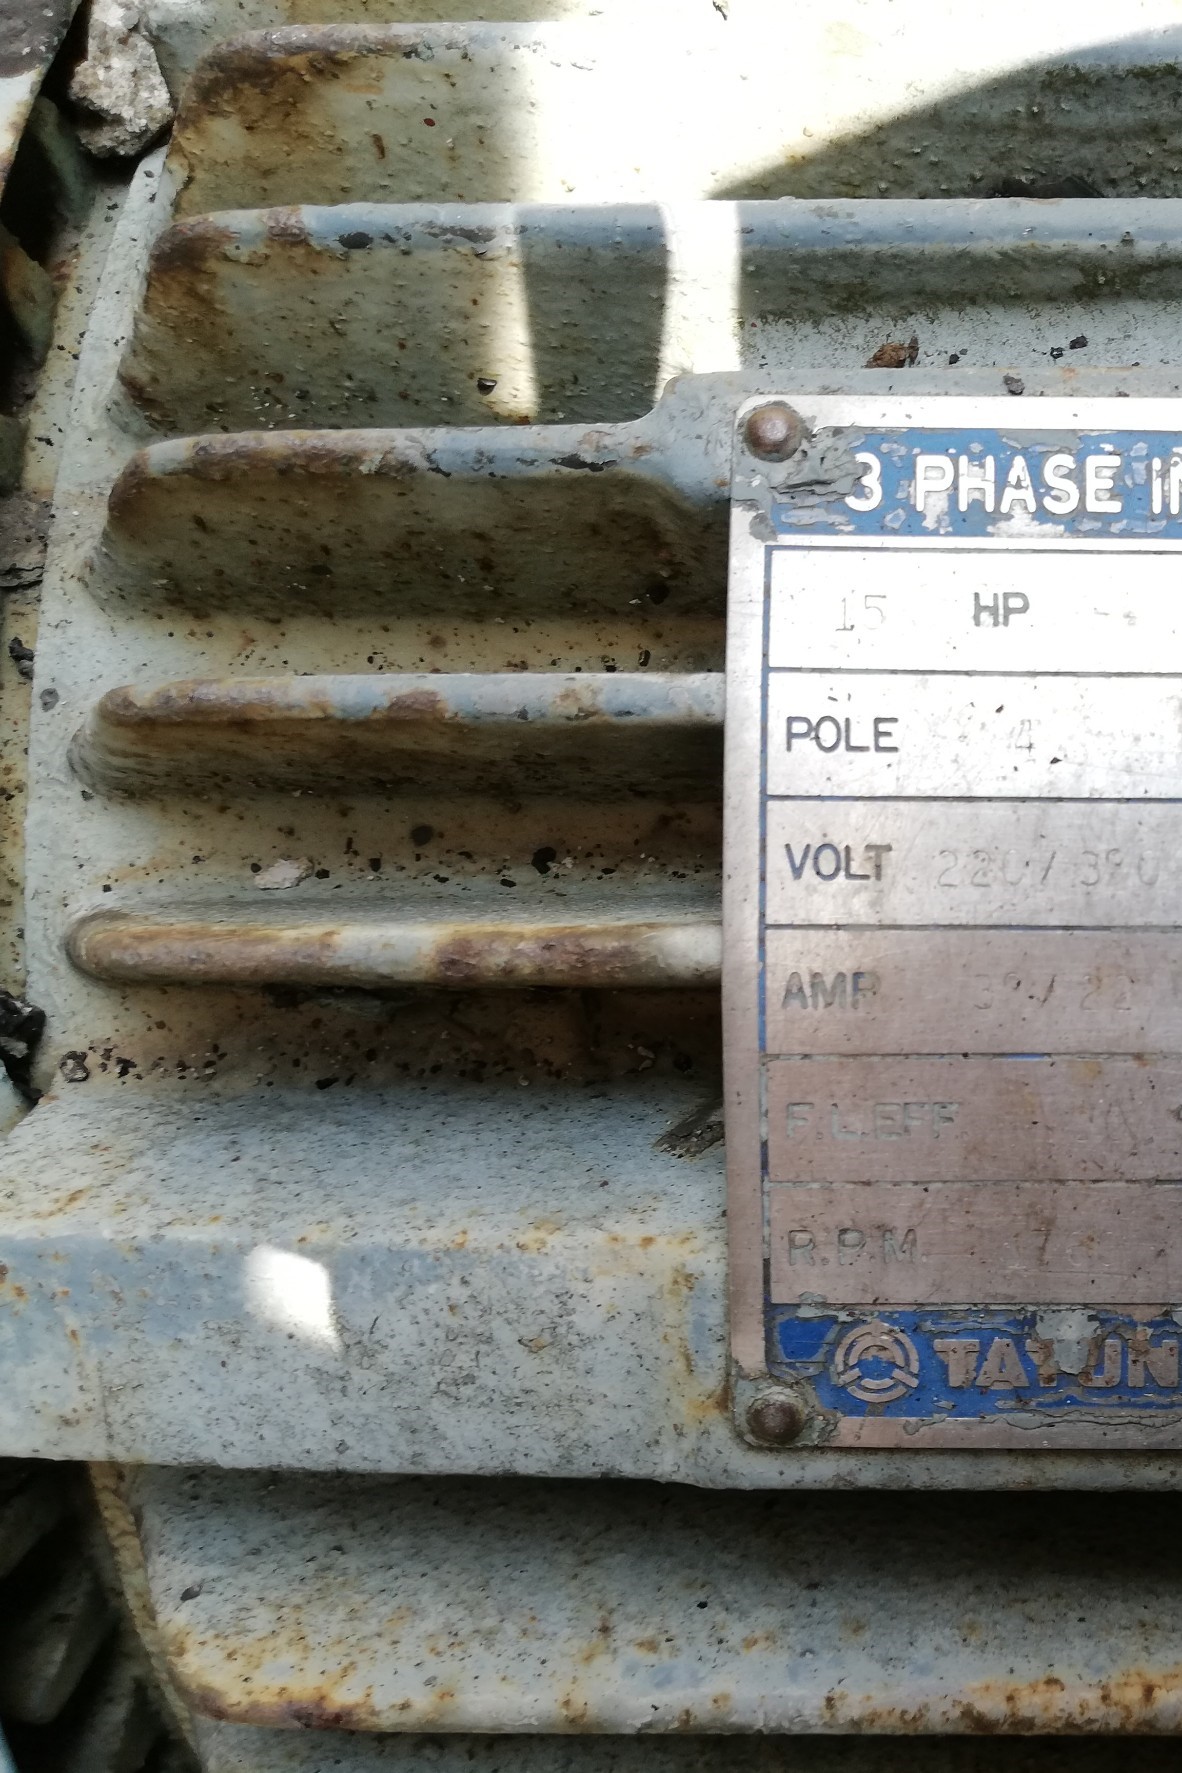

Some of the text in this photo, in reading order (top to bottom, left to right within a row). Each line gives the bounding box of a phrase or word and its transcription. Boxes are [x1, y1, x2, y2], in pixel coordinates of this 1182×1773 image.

[844, 453, 882, 512] 3
[914, 453, 1123, 515] PHASE
[972, 592, 1030, 627] HP
[786, 715, 898, 754] POLE
[784, 843, 893, 882] VOLT
